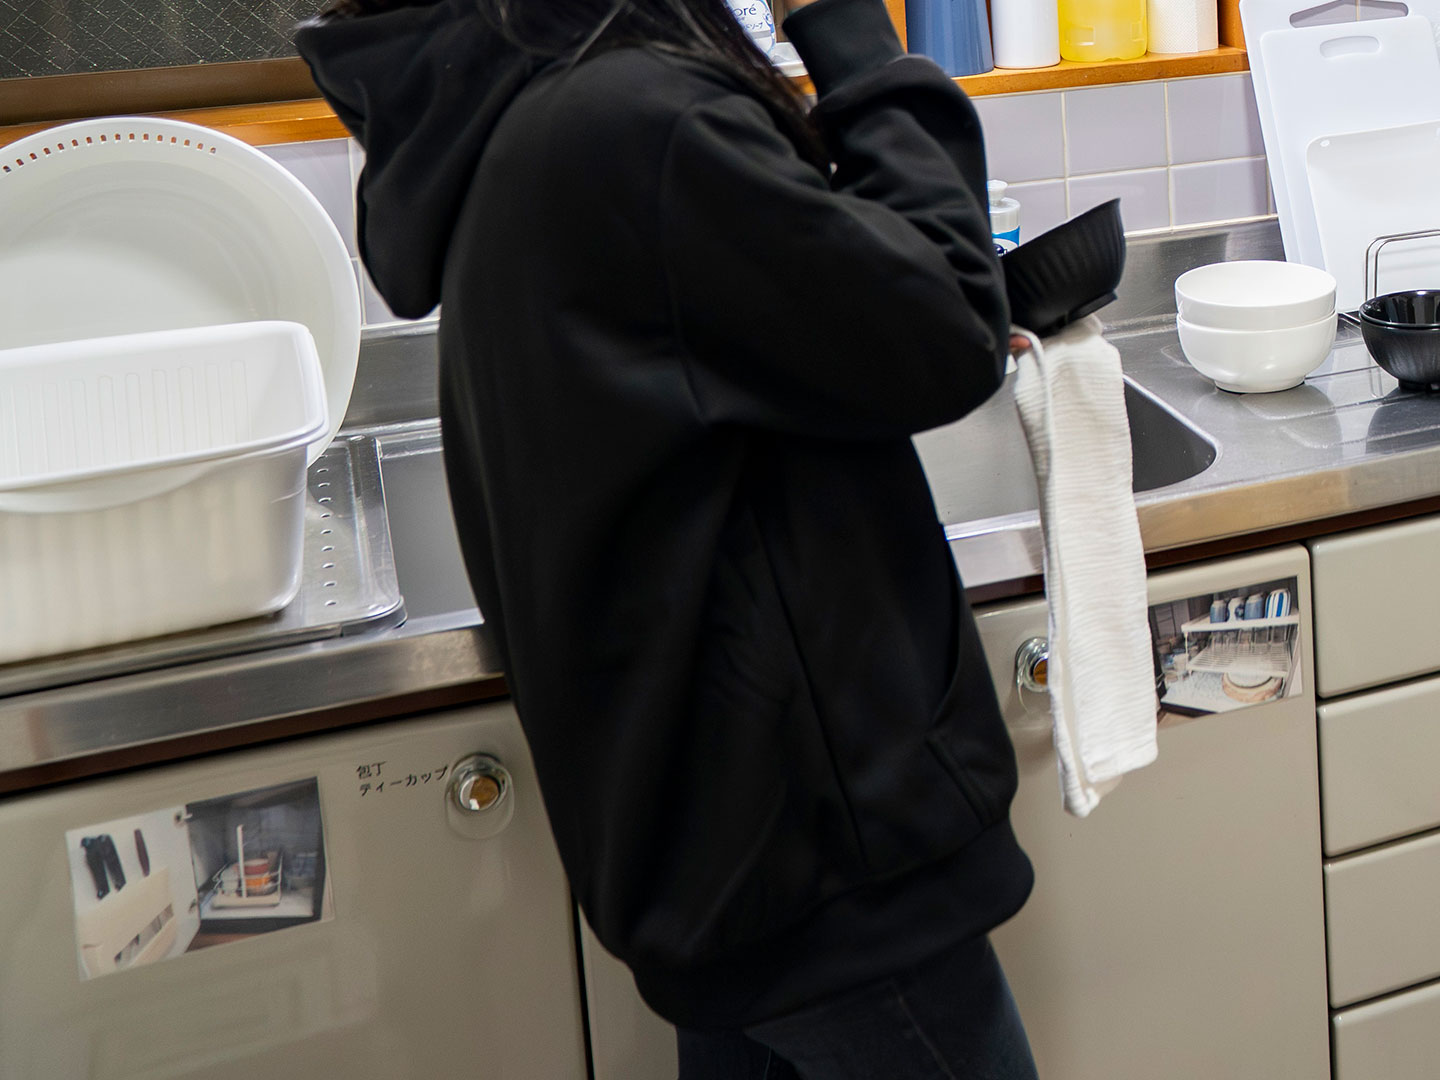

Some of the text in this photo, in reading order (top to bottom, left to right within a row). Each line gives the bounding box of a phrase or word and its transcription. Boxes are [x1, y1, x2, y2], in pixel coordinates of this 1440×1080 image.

[733, 3, 757, 17] oré
[356, 761, 386, 779] 包丁
[359, 765, 449, 797] ティーカップ
